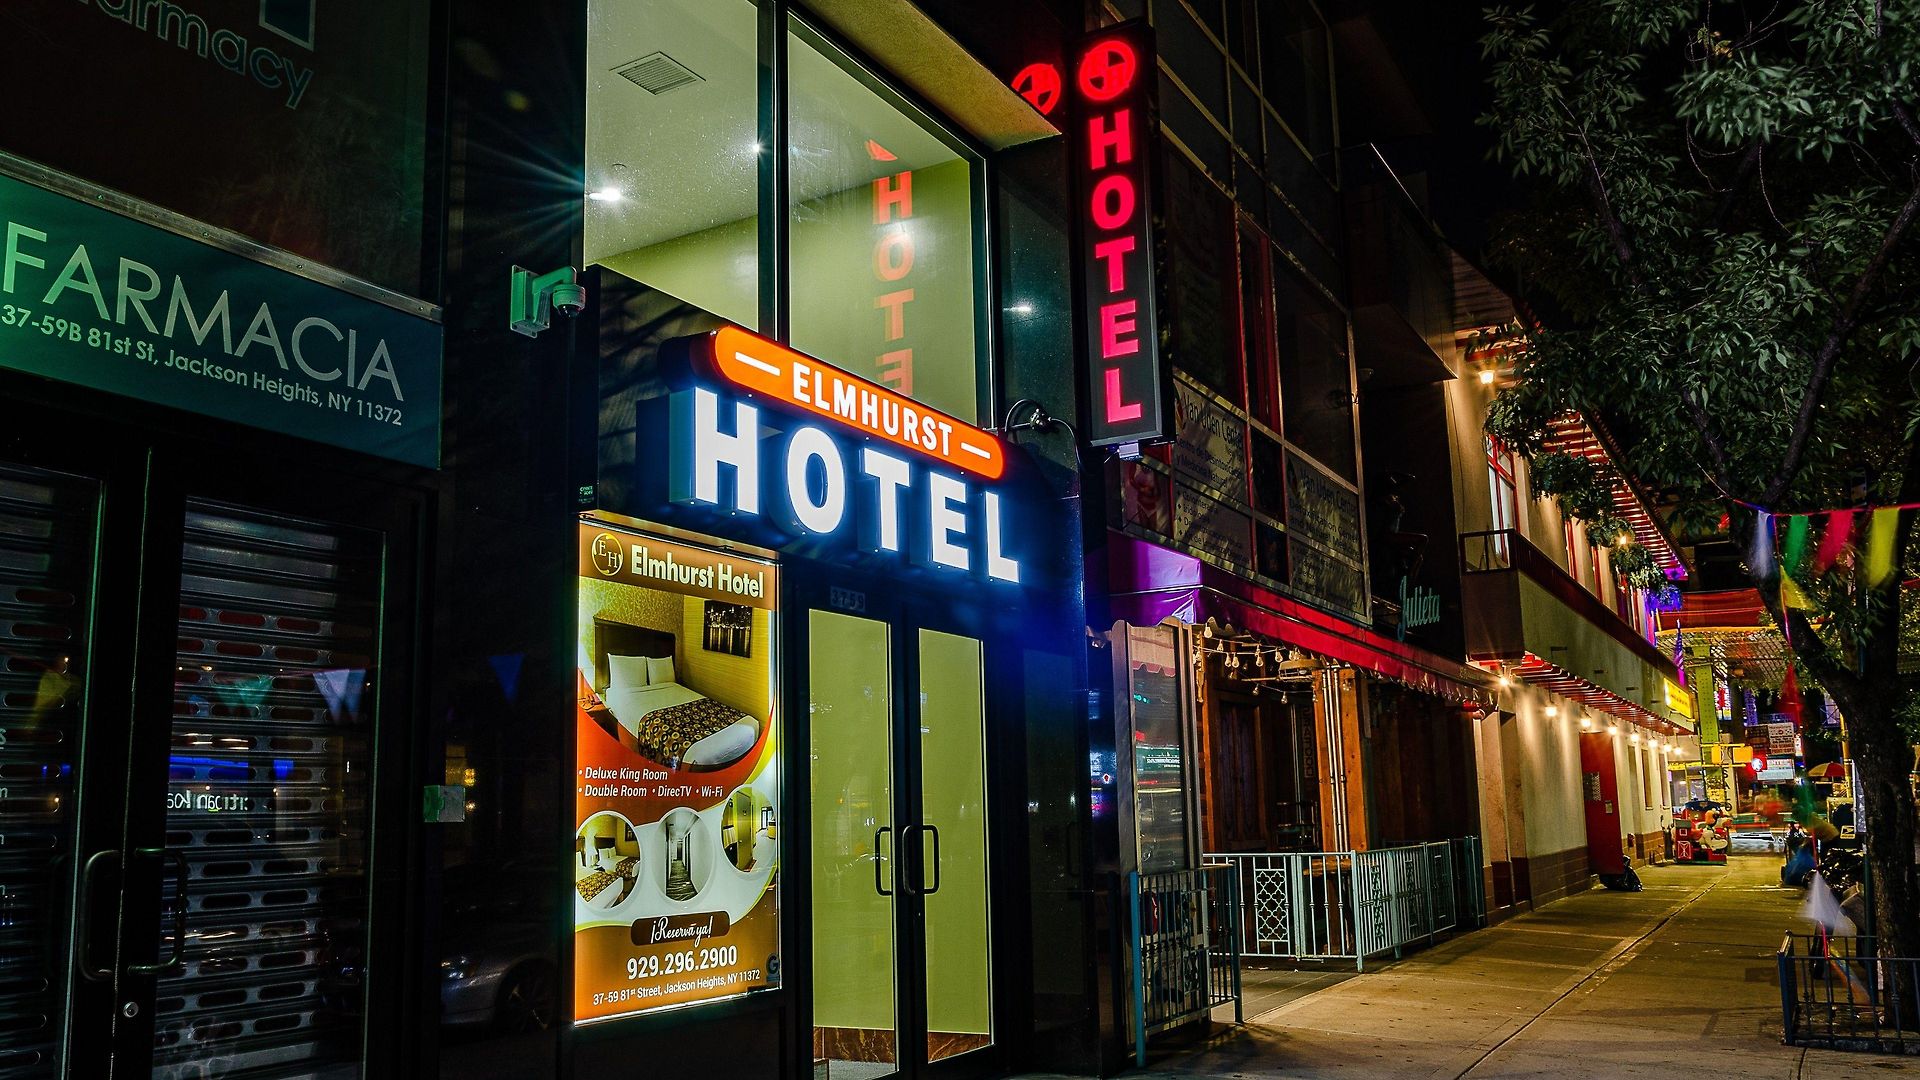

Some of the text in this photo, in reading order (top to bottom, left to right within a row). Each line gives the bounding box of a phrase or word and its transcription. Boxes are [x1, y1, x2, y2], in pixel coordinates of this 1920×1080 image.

[78, 0, 315, 110] armacy
[1089, 108, 1143, 424] HOTEL
[2, 221, 405, 402] FARMACIA
[1, 304, 403, 426] 37-59B 81st St, Jackson Heights, NY 11372
[793, 361, 952, 457] ELMHURST
[695, 386, 1020, 584] HOTEL
[631, 544, 764, 599] Elmhurst Hotel
[832, 588, 863, 610] 3759
[1397, 575, 1440, 641] Julieta
[584, 766, 668, 782] Deluxe King Room
[584, 784, 723, 797] Double Room DirecTV Wi-Fi
[593, 989, 619, 1005] 37-59
[620, 988, 636, 1002] 81st
[637, 985, 663, 998] Street,
[664, 980, 695, 995] Jackson
[697, 974, 727, 990] Heights,
[727, 971, 738, 984] NY
[739, 969, 760, 983] 11372
[627, 945, 738, 980] 929.296.2900
